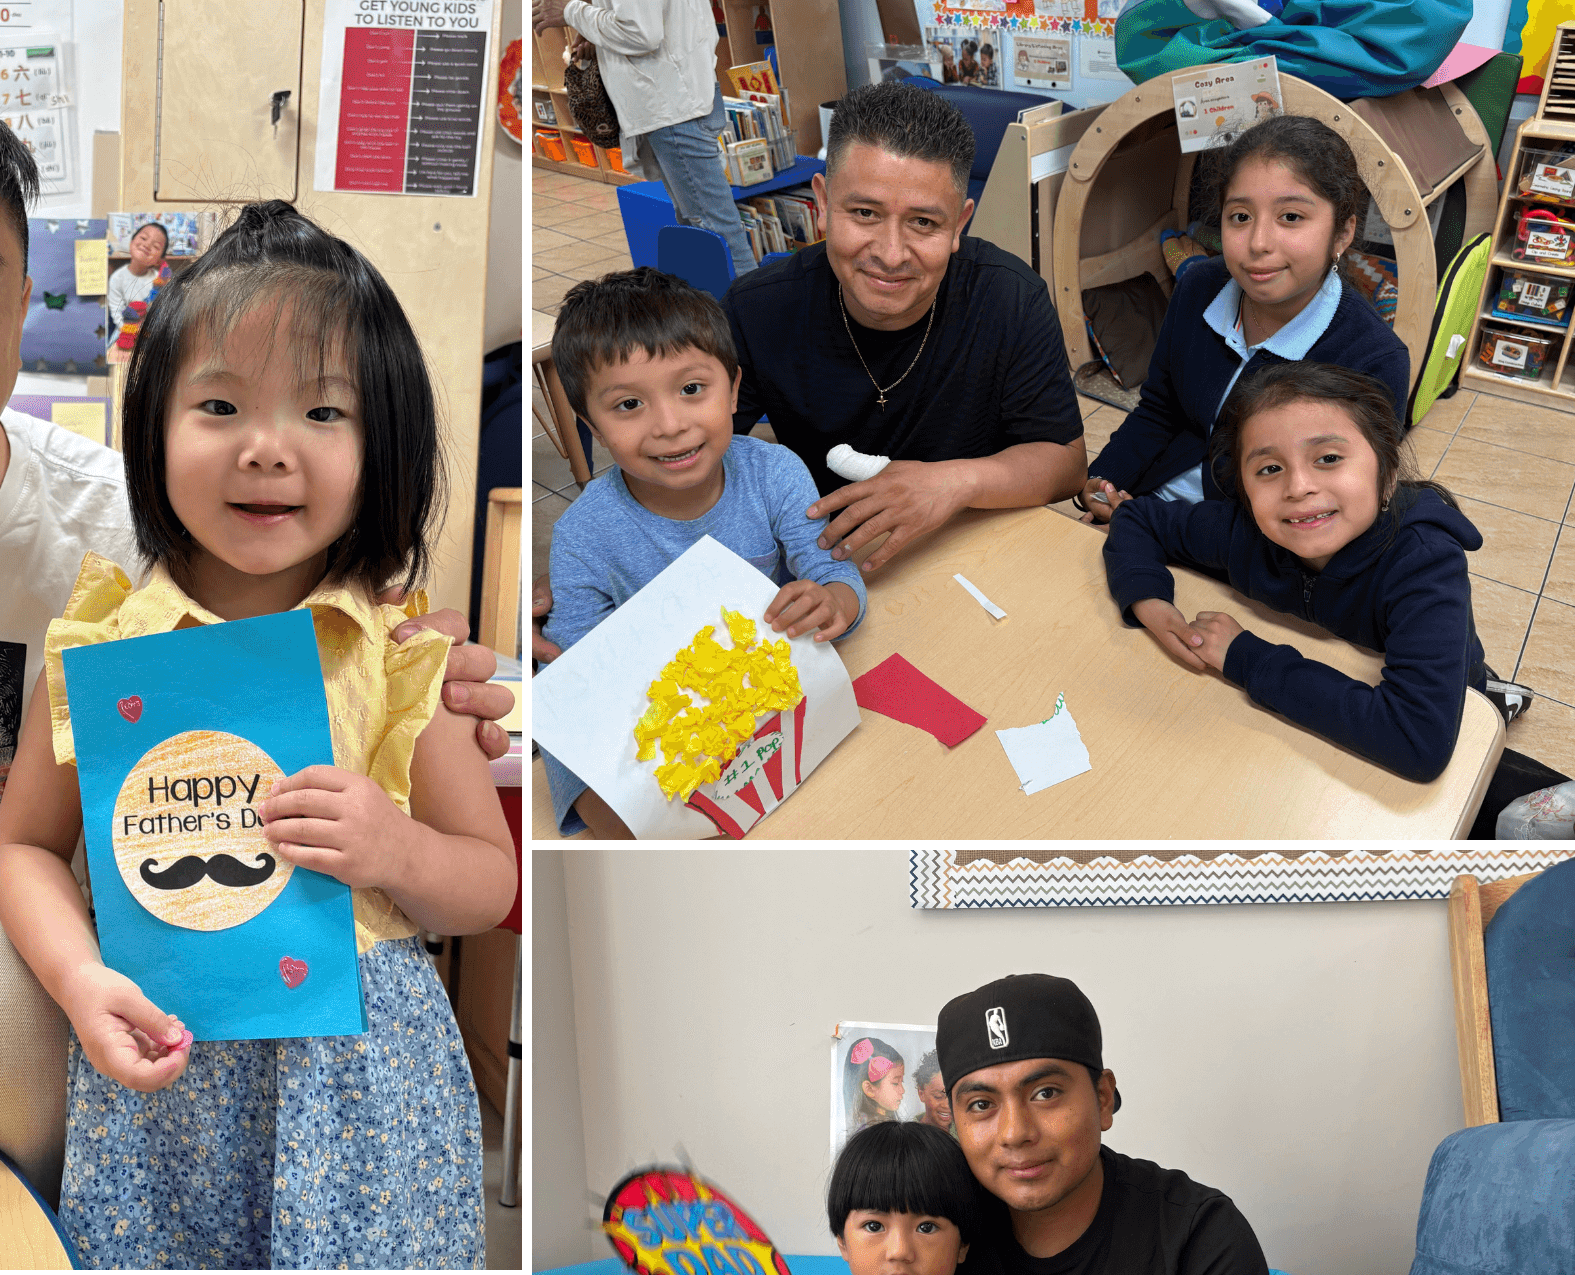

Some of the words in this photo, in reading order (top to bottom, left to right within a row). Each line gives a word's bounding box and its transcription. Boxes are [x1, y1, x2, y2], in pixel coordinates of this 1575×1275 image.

[359, 0, 386, 11] GET
[390, 1, 440, 14] YOUNG
[444, 3, 476, 14] KIDS
[355, 14, 374, 25] TO
[377, 15, 423, 27] LISTEN
[426, 16, 446, 27] TO
[449, 17, 479, 29] YOU
[0, 69, 9, 80] 6
[13, 65, 30, 82] 六
[1194, 80, 1213, 88] Cozy
[1215, 76, 1234, 85] Area
[2, 93, 10, 105] 7
[15, 89, 32, 106] 七
[1209, 105, 1234, 113] Children
[147, 773, 262, 808] Happy
[123, 808, 232, 836] Father's
